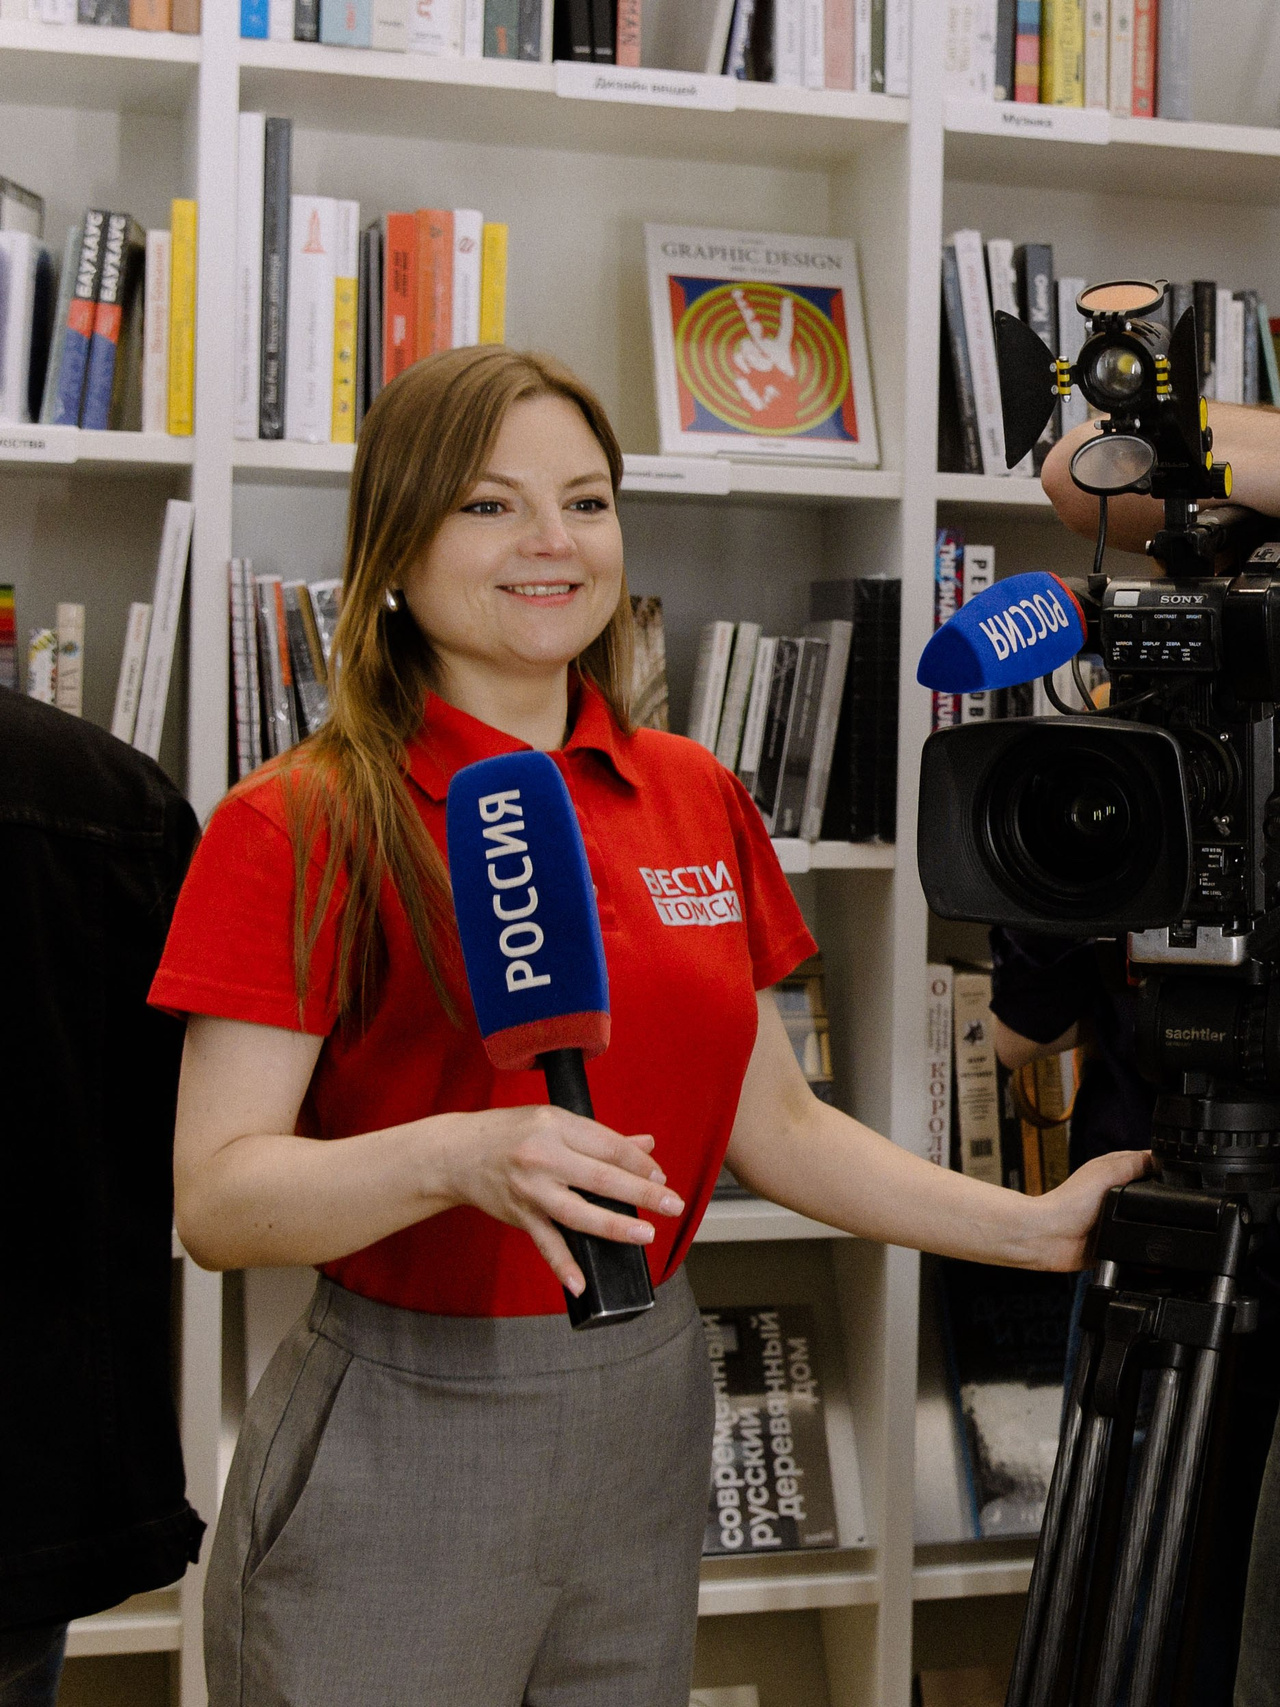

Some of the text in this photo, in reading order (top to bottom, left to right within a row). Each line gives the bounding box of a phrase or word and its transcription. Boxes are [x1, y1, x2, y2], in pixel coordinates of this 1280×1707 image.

[1002, 112, 1055, 129] Музыка
[75, 210, 104, 299] БАУХАУС
[99, 214, 126, 303] БАУХАУС
[661, 240, 761, 266] GRAPHIC
[765, 249, 843, 271] DESIGN
[940, 543, 957, 577] THE
[979, 590, 1068, 661] РОССИЯ
[1160, 594, 1204, 605] SONY
[479, 789, 551, 992] РОССИЯ
[639, 860, 734, 897] ВЕСТИ
[659, 895, 741, 921] ТОМСК
[1165, 1026, 1227, 1043] sachtler
[786, 1336, 821, 1405] дом
[701, 1313, 746, 1550] современный
[750, 1311, 808, 1521] деревянный
[730, 1406, 782, 1548] русский
